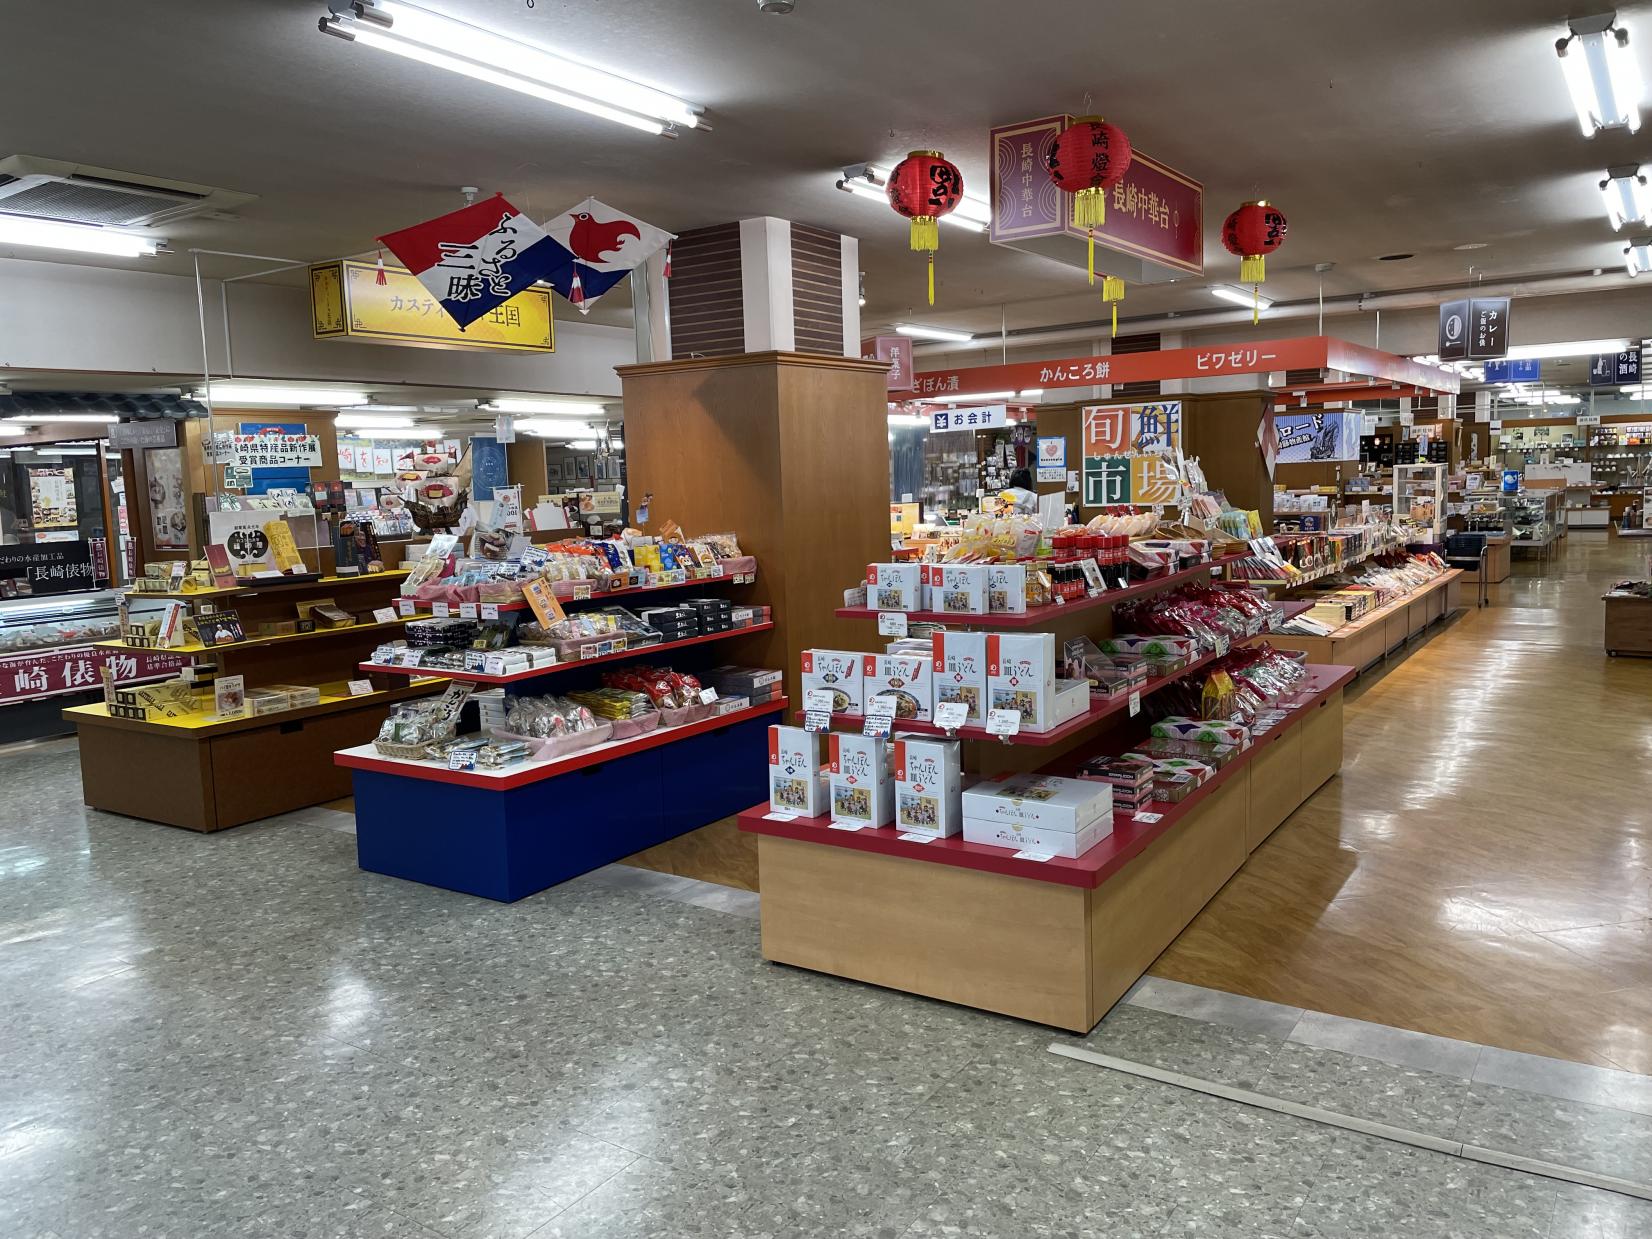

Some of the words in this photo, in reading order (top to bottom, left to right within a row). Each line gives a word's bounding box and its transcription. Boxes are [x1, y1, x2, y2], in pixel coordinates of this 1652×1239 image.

[479, 213, 519, 296] ふるさと
[437, 241, 481, 302] 三昧
[1489, 310, 1498, 346] カレー
[890, 346, 901, 380] 洋菓子
[1038, 361, 1110, 383] かんころ餅
[1196, 350, 1277, 371] ビワゼリー
[1619, 353, 1628, 375] の酒
[1628, 351, 1638, 374] 長崎
[954, 411, 992, 425] お会計
[1084, 404, 1179, 449] 旬鮮
[239, 455, 311, 465] 受賞商品コーナー
